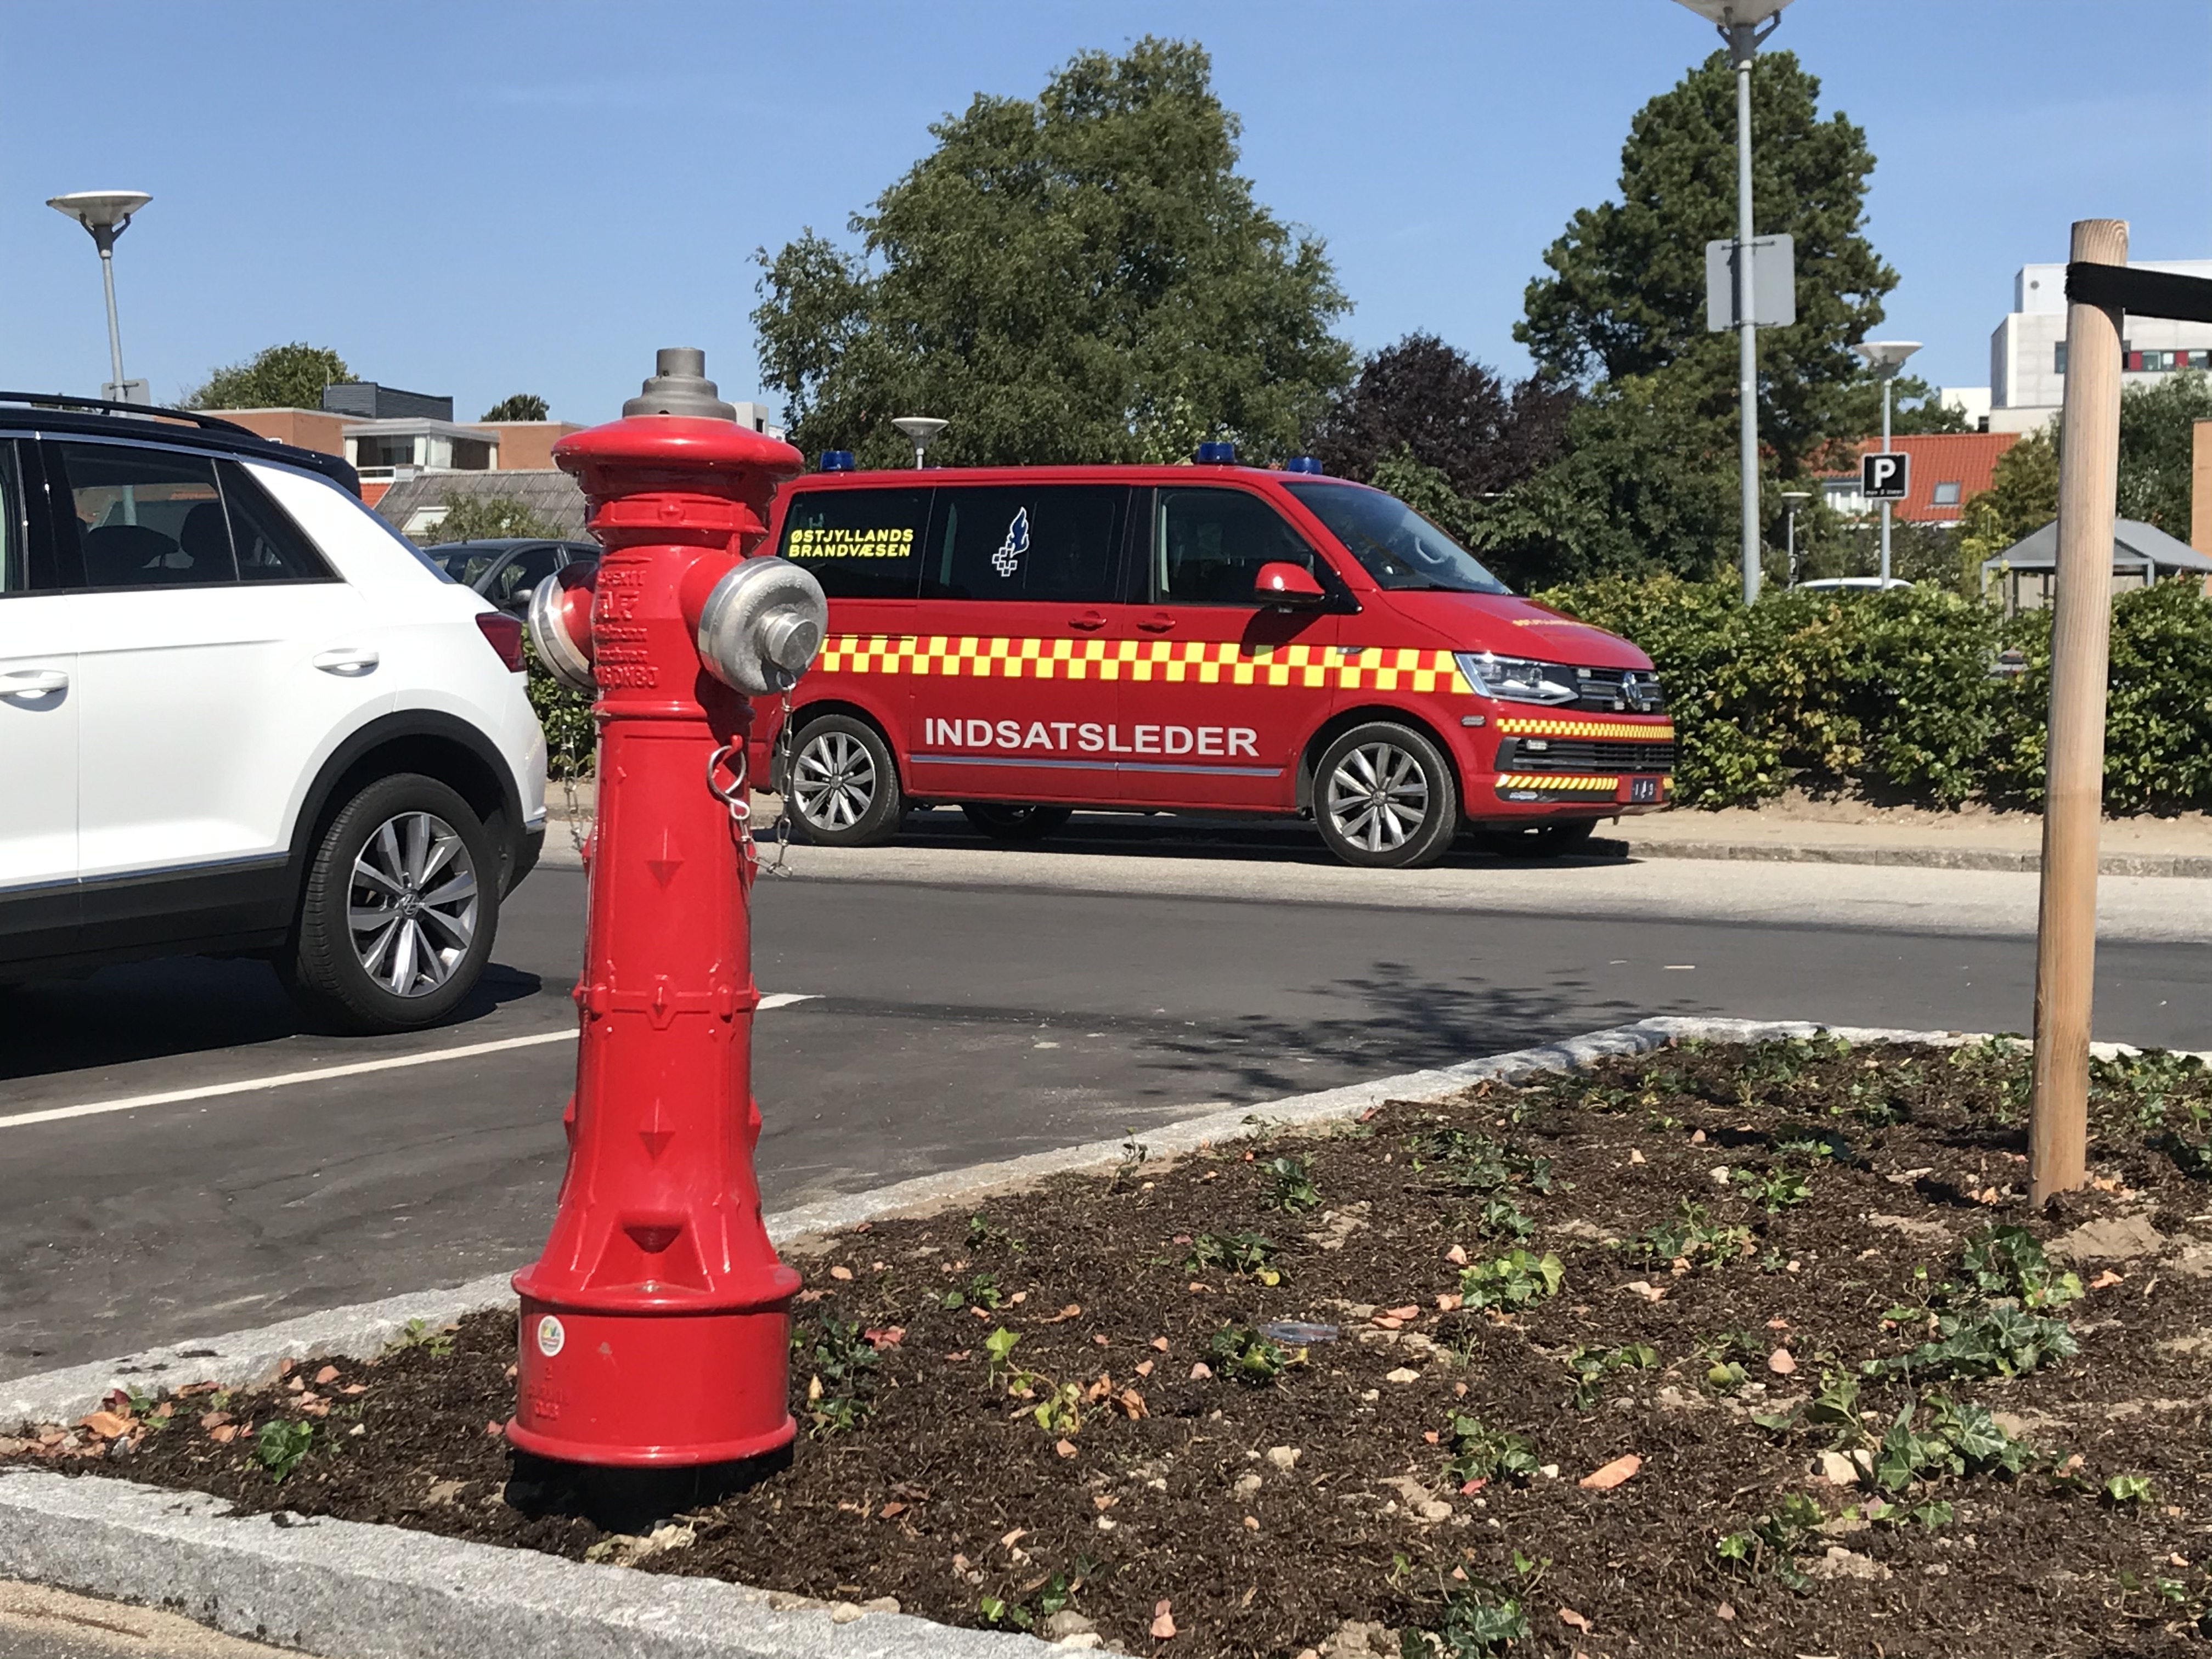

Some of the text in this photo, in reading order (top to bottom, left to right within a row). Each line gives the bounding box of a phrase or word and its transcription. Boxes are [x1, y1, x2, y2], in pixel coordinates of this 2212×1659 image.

[1875, 458, 1896, 488] P
[791, 529, 913, 543] ØSTJYLLANDS
[789, 544, 911, 557] BRANDVÆSEN
[926, 718, 1259, 757] INDSATSLEDER
